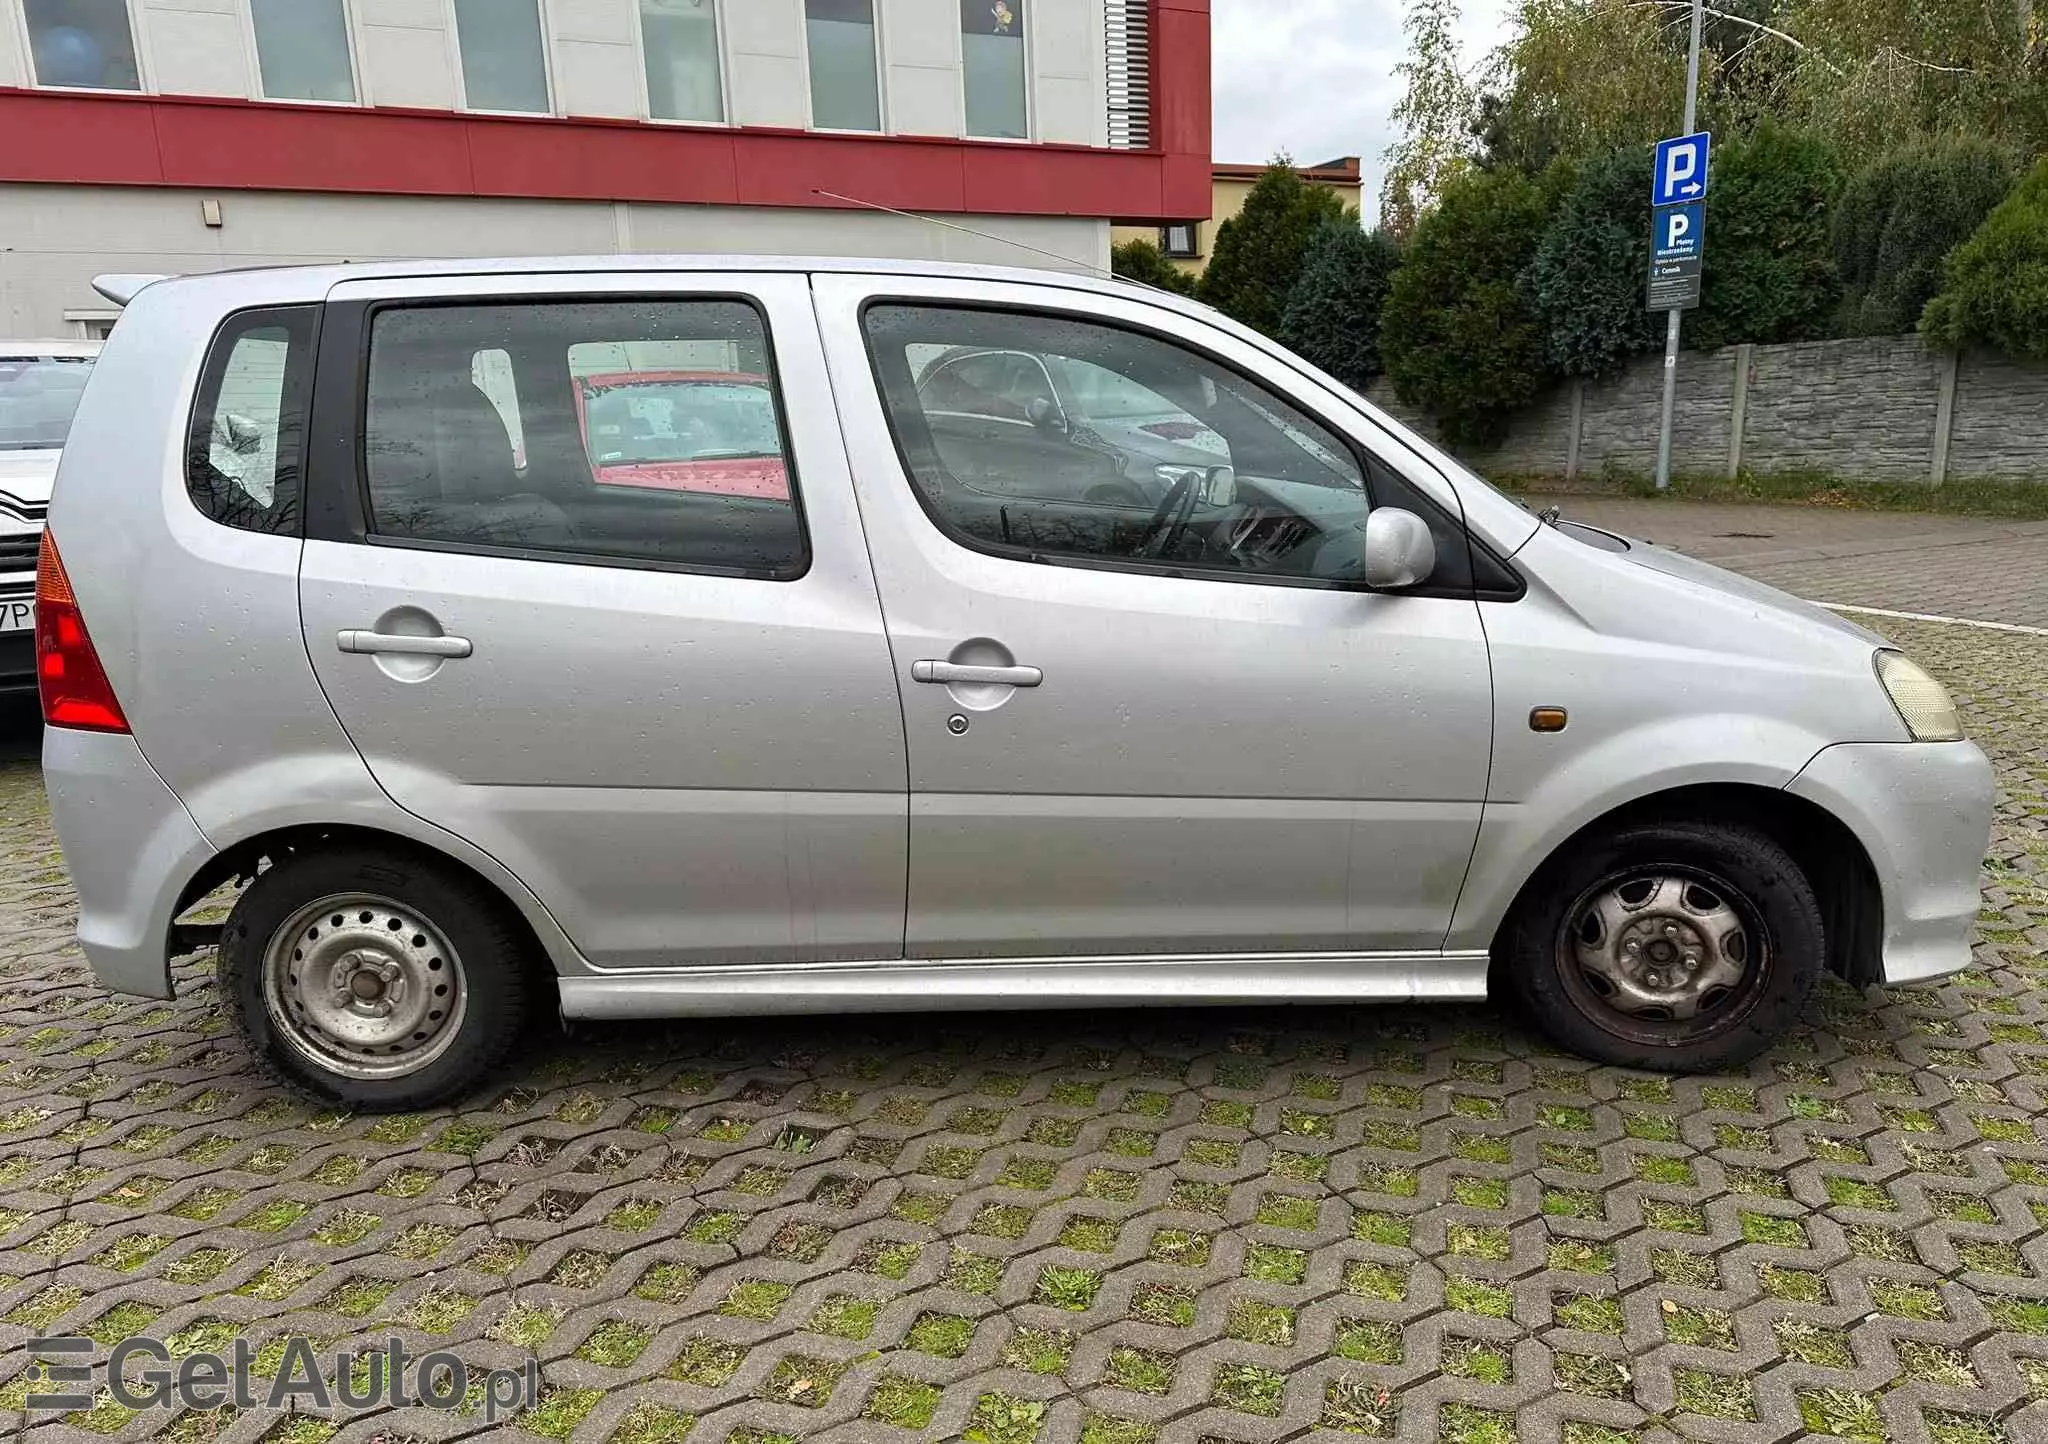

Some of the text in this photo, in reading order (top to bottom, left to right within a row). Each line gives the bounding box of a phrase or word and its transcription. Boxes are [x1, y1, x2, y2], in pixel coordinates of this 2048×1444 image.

[1664, 143, 1696, 197] P
[1668, 214, 1689, 247] P
[0, 603, 36, 628] 7P
